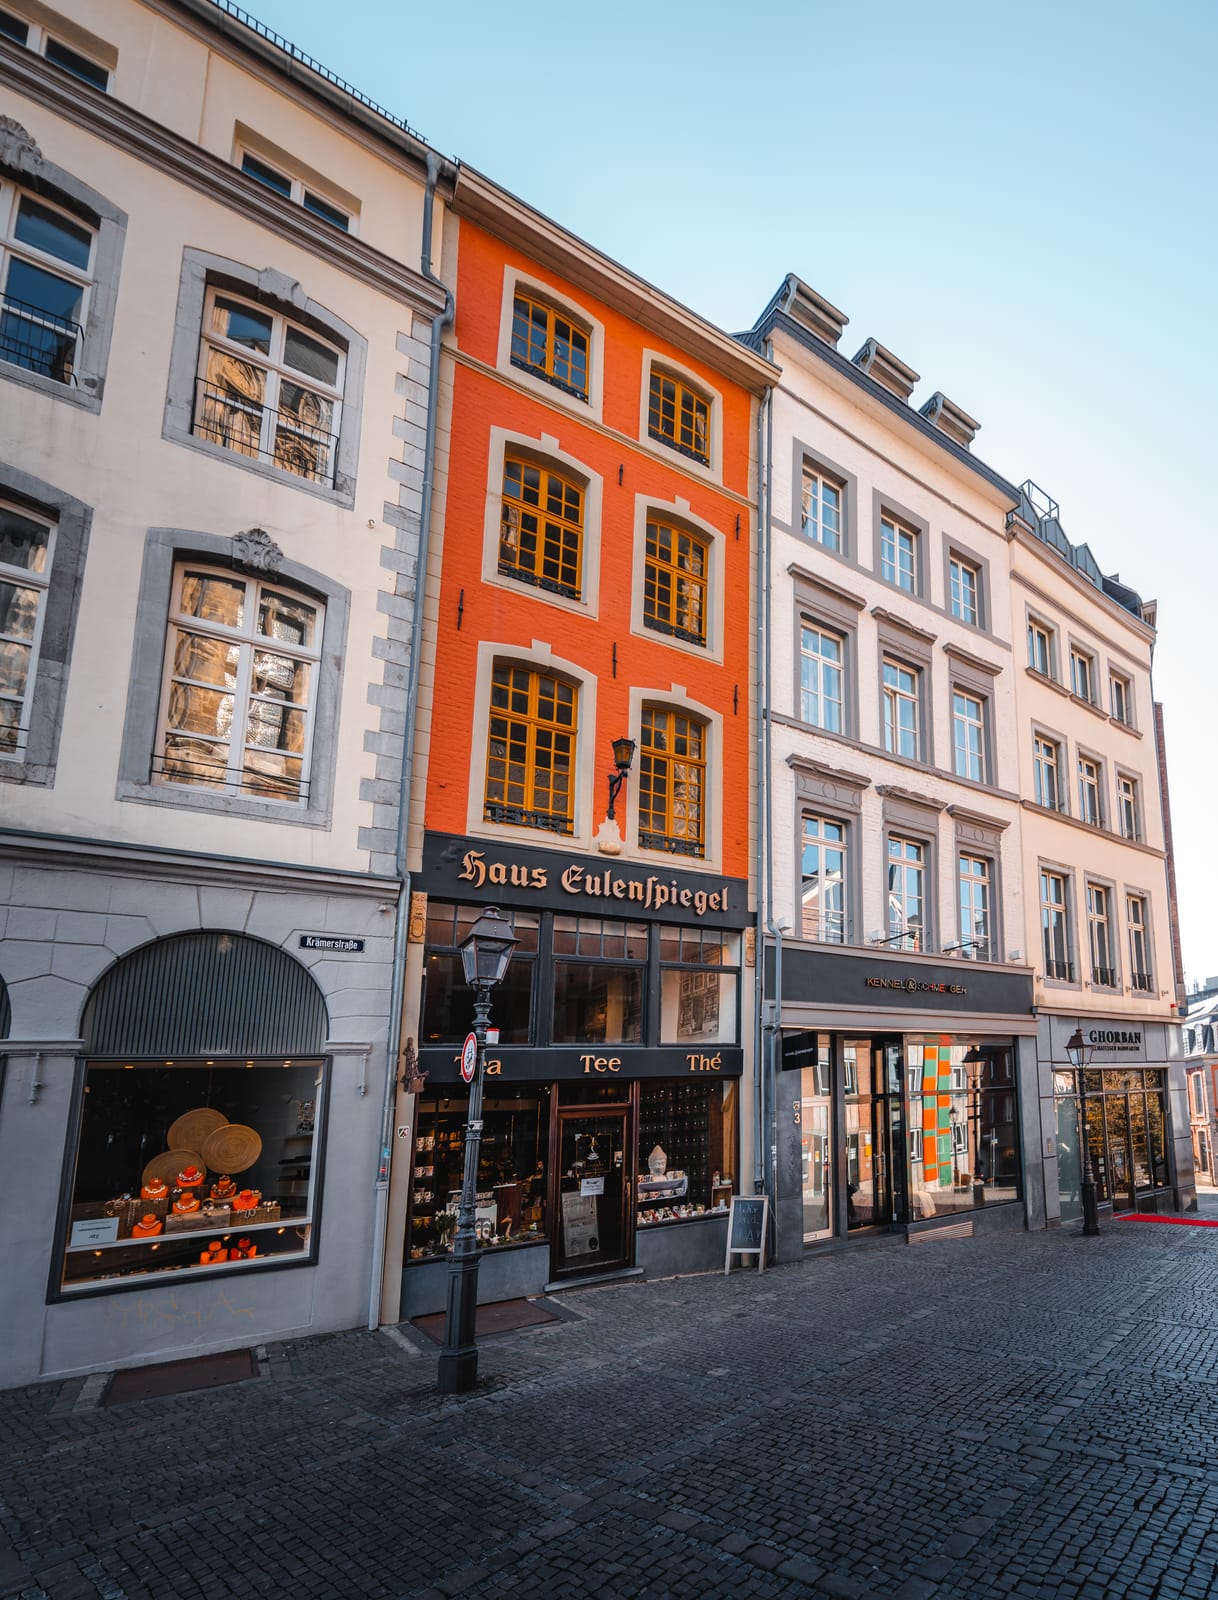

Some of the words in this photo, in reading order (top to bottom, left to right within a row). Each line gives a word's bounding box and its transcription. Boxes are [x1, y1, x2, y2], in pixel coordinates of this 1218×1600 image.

[458, 850, 548, 889] Haus
[306, 937, 358, 950] Krämerstraße
[866, 977, 906, 989] KENNEL
[1089, 1030, 1141, 1044] GHORBAN
[579, 1055, 622, 1073] Tee
[686, 1052, 722, 1071] Thé
[794, 1112, 801, 1124] 3
